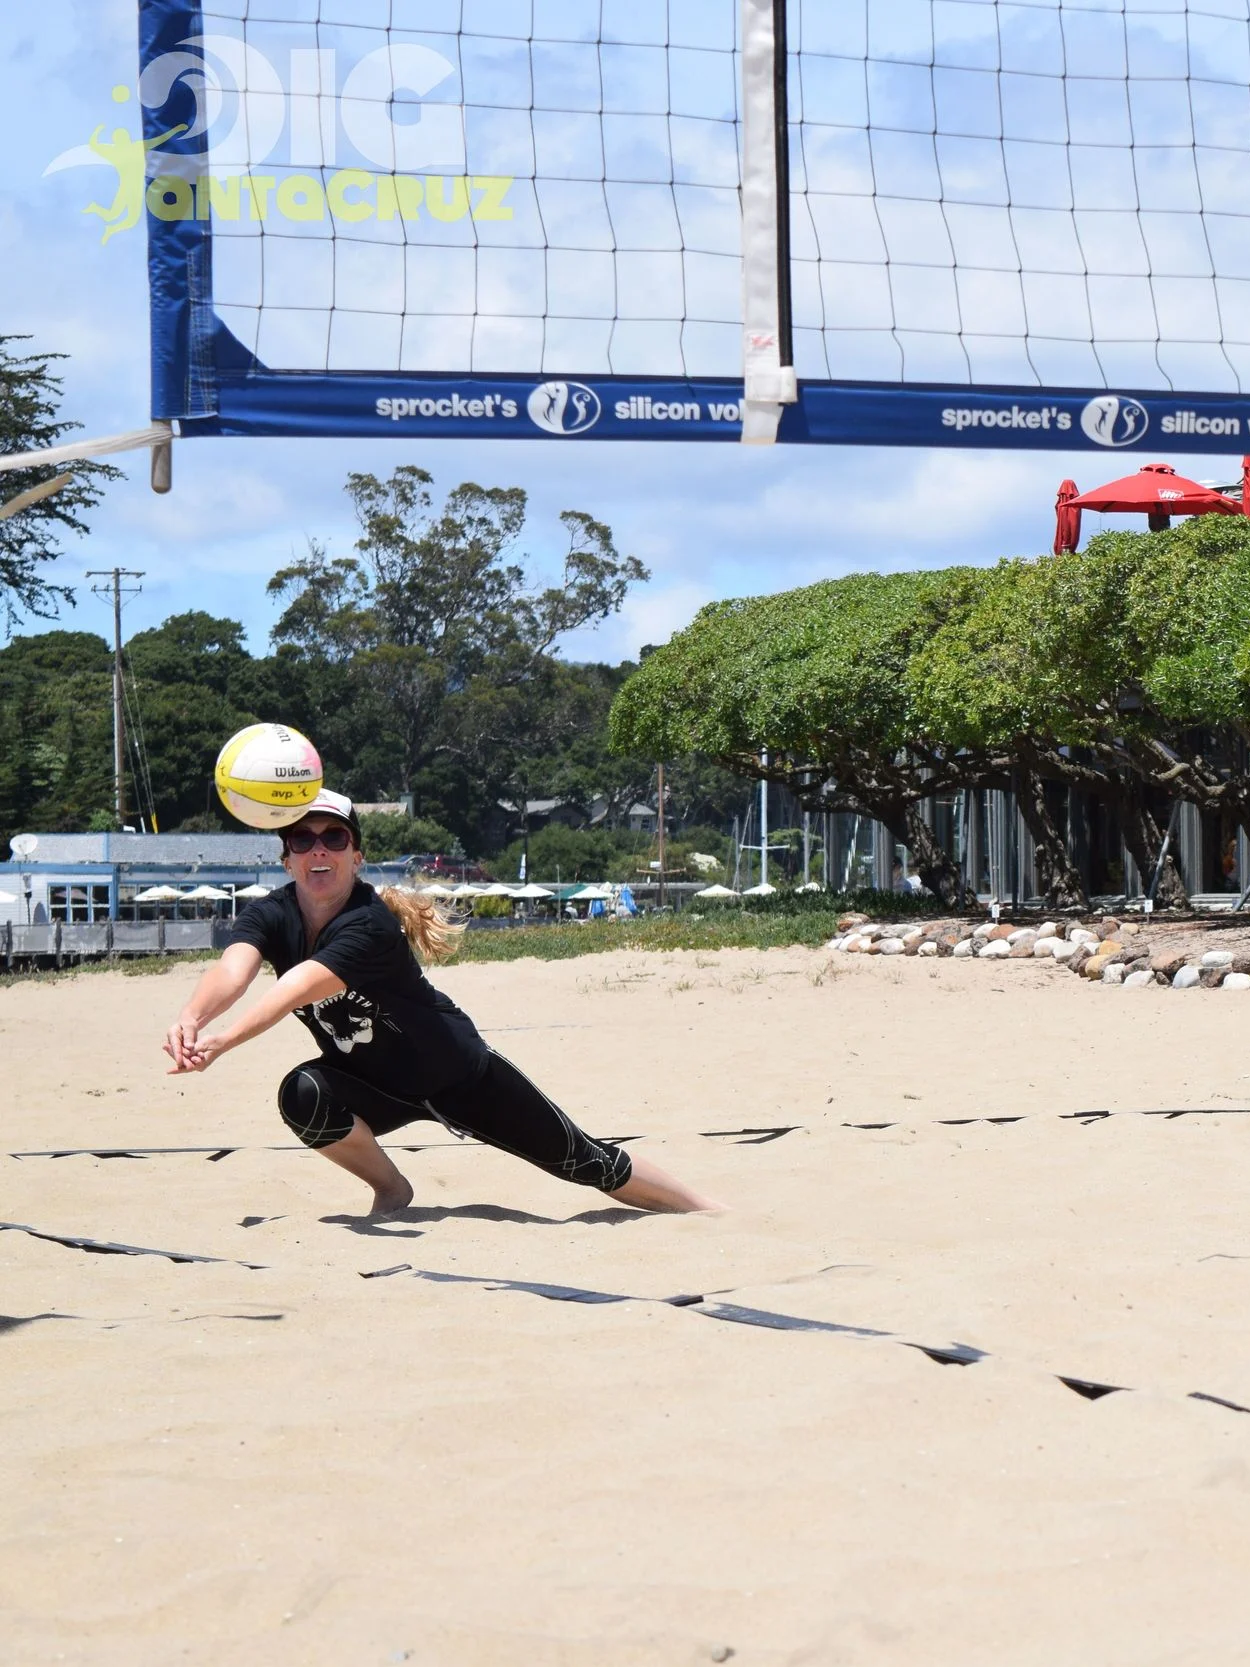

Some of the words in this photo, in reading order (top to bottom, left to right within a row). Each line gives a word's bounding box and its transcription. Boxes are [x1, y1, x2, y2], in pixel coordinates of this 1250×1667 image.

[376, 393, 518, 421] sprocket's
[614, 396, 701, 421] silicon
[708, 398, 745, 422] vol
[942, 405, 1072, 431] sprocket's
[1161, 411, 1240, 435] silicon
[275, 766, 311, 778] Wilson
[271, 790, 293, 800] avp
[347, 990, 373, 1008] GTH
